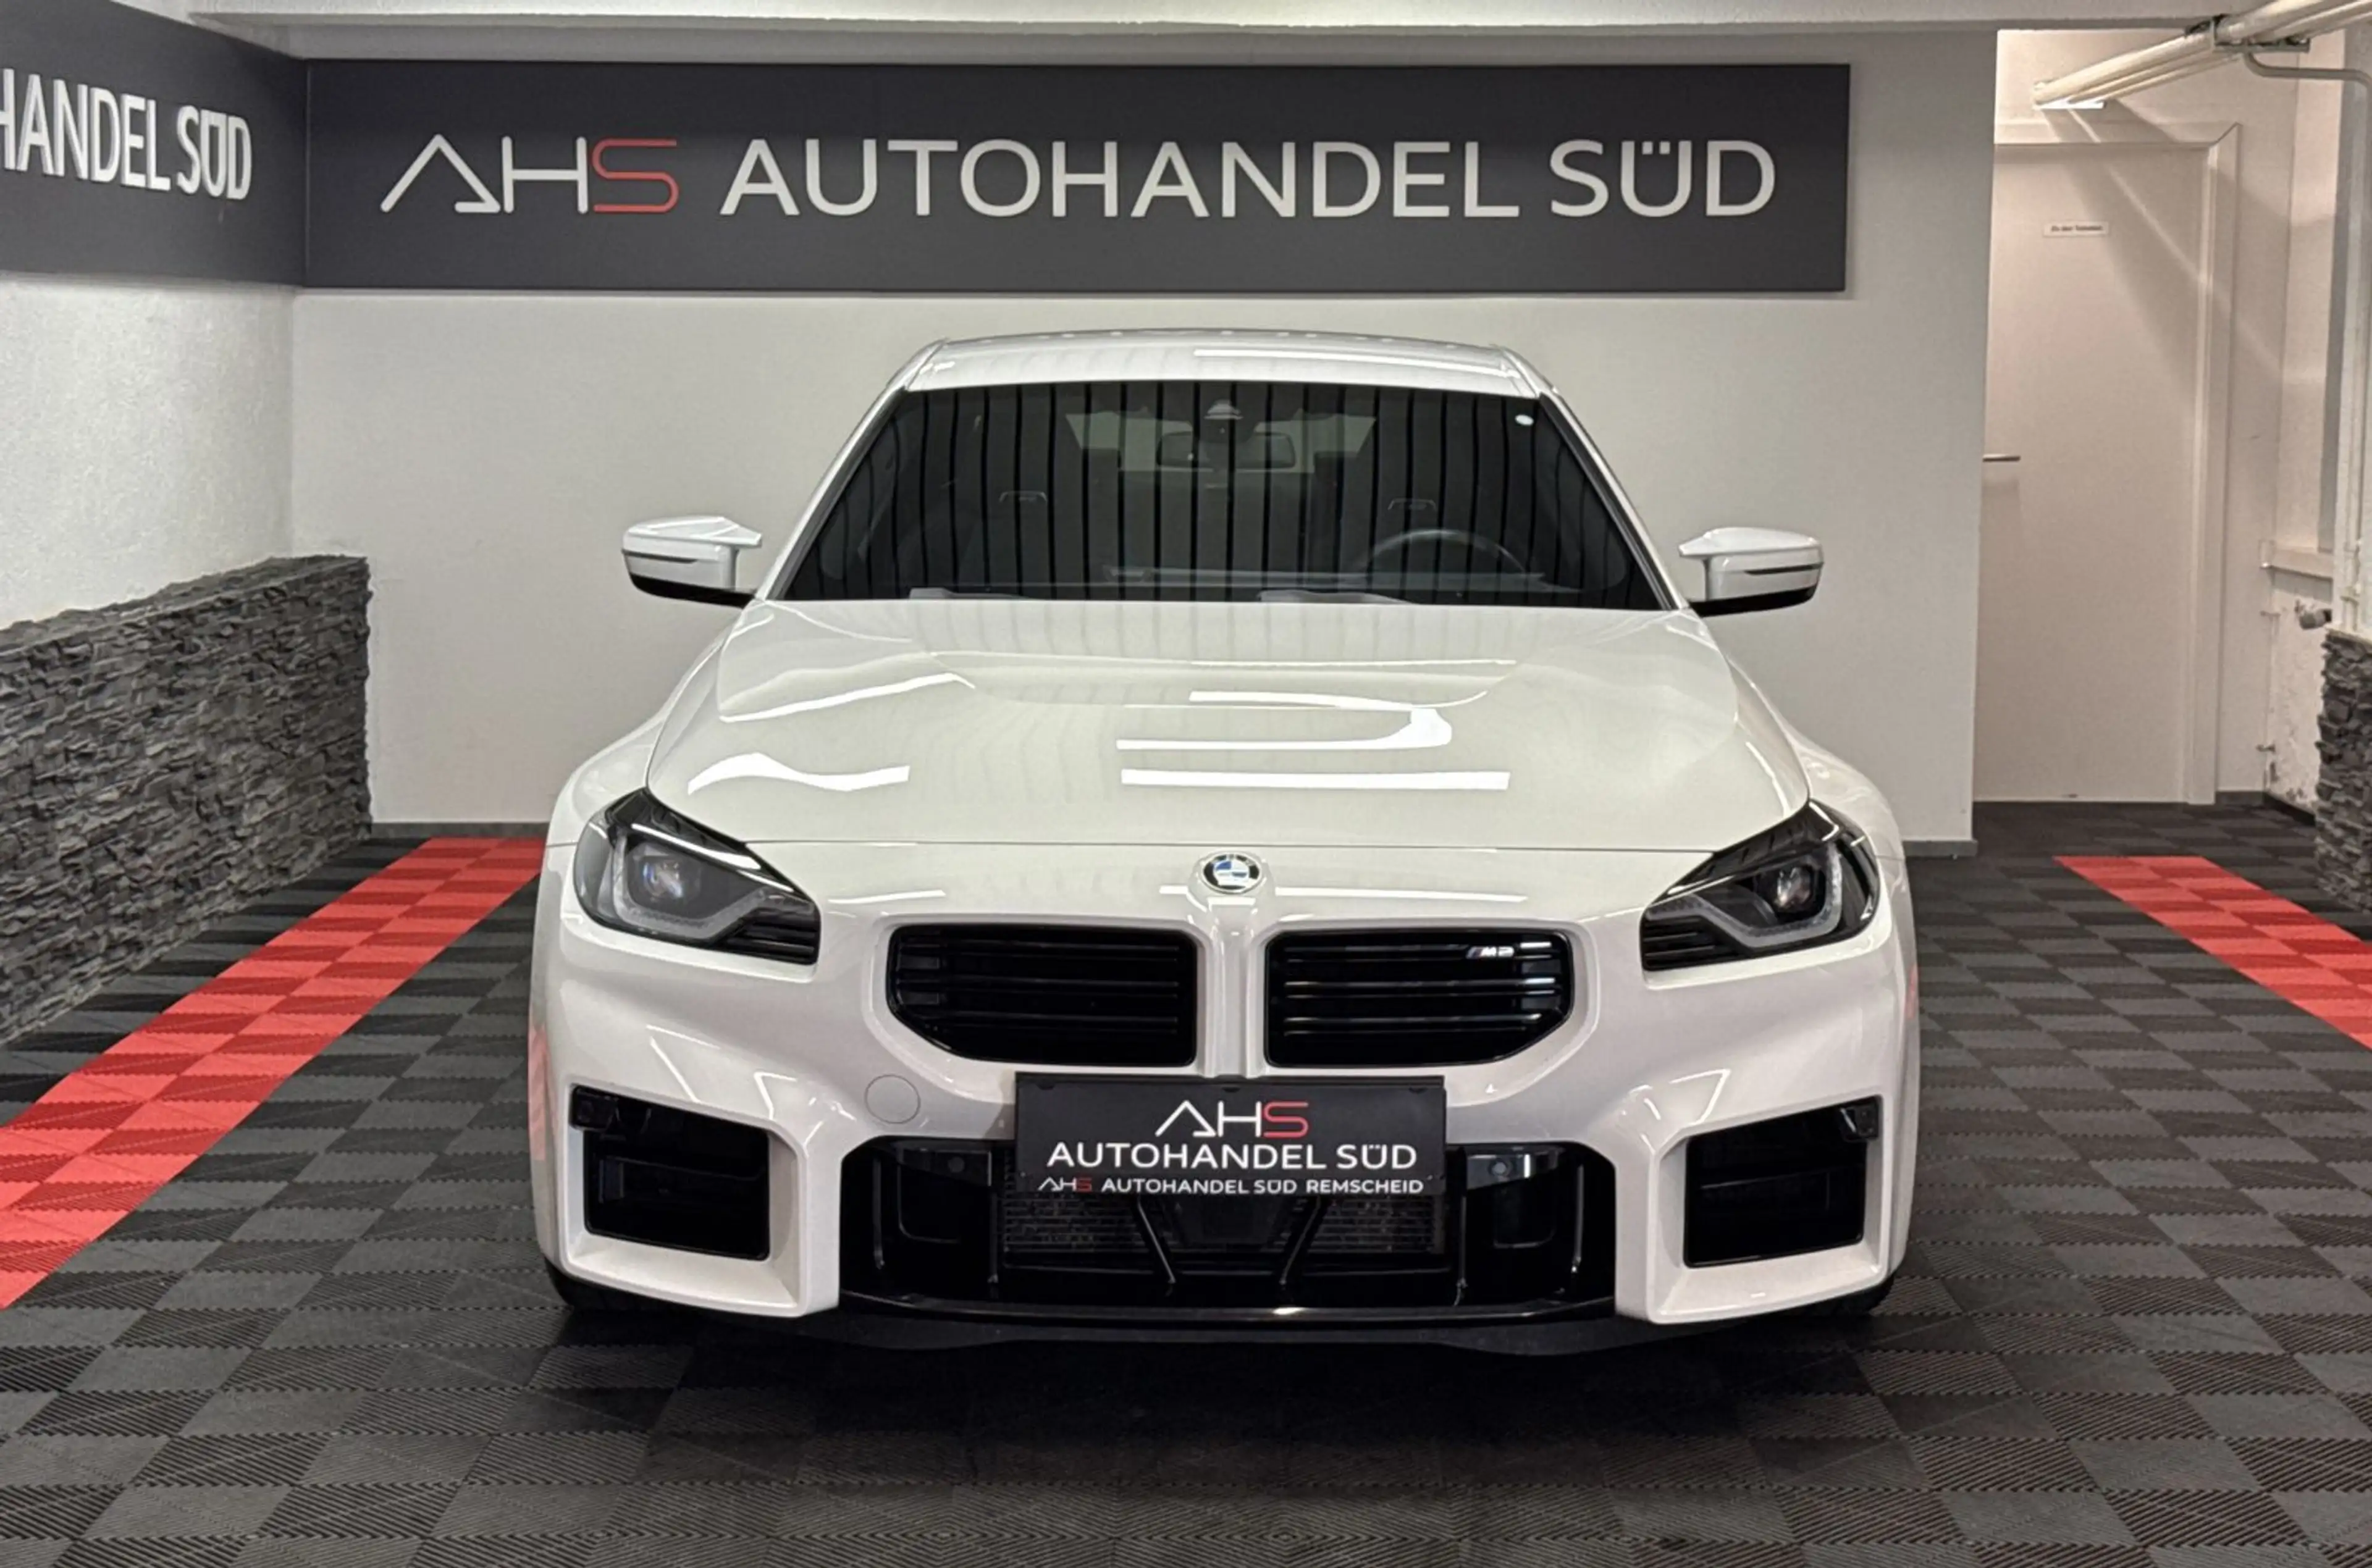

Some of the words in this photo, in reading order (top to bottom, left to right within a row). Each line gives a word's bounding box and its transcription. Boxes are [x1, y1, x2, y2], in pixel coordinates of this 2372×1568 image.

[177, 105, 252, 200] SÜD
[381, 135, 679, 214] AHS
[720, 139, 1520, 218] AUTOHANDEL
[1550, 140, 1775, 218] SÜD
[1154, 1099, 1309, 1139] AHS
[1047, 1141, 1327, 1170] AUTOHANDEL
[1336, 1144, 1417, 1170] SÜD
[1038, 1176, 1092, 1193] AHS
[1101, 1178, 1248, 1194] AUTOHANDEL
[1254, 1179, 1297, 1194] SÜD
[1306, 1179, 1424, 1194] REMSCHEID
